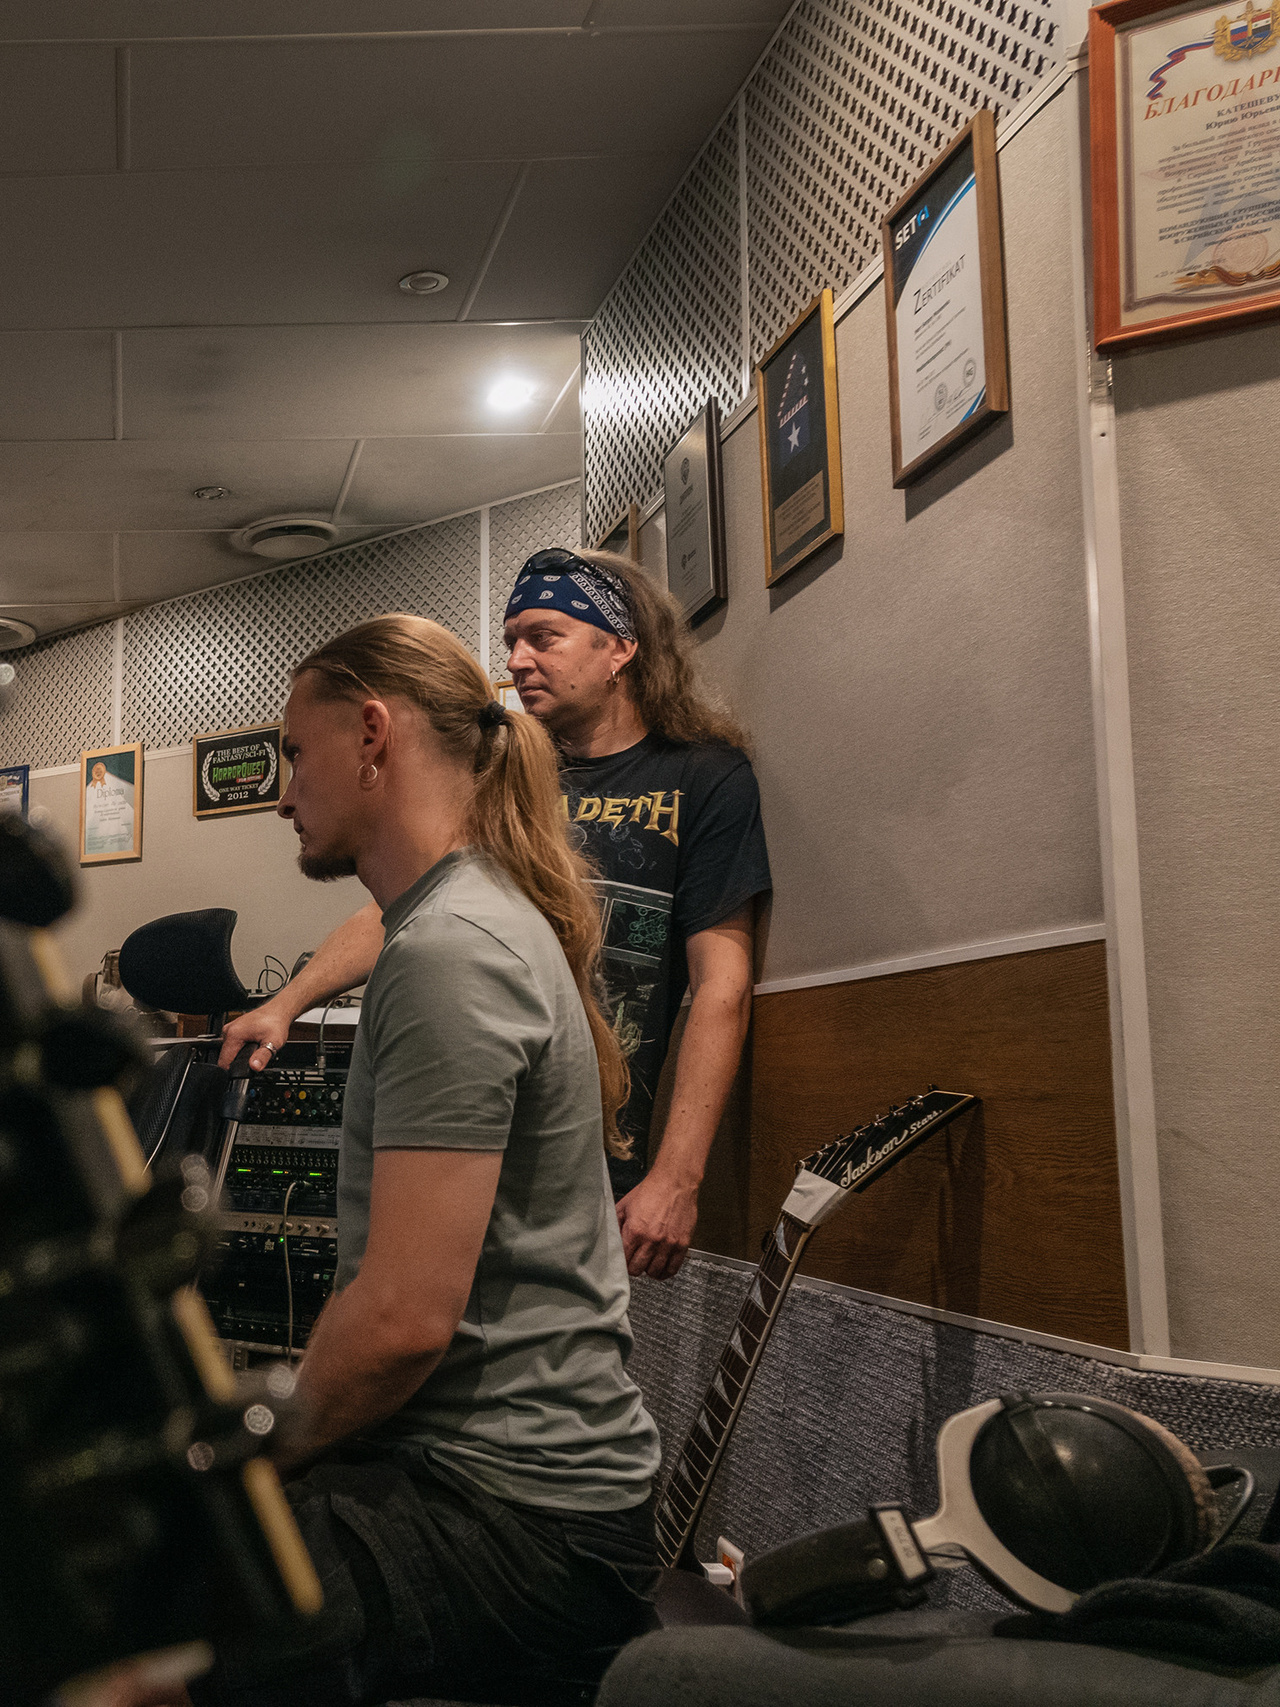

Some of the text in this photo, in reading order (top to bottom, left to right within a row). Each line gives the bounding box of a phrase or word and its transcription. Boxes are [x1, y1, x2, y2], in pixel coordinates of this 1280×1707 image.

[895, 214, 917, 251] SET
[216, 749, 231, 757] THE
[232, 746, 249, 755] BEST
[96, 788, 124, 800] Diploma
[227, 791, 249, 801] 2012
[840, 1129, 909, 1187] Jackson
